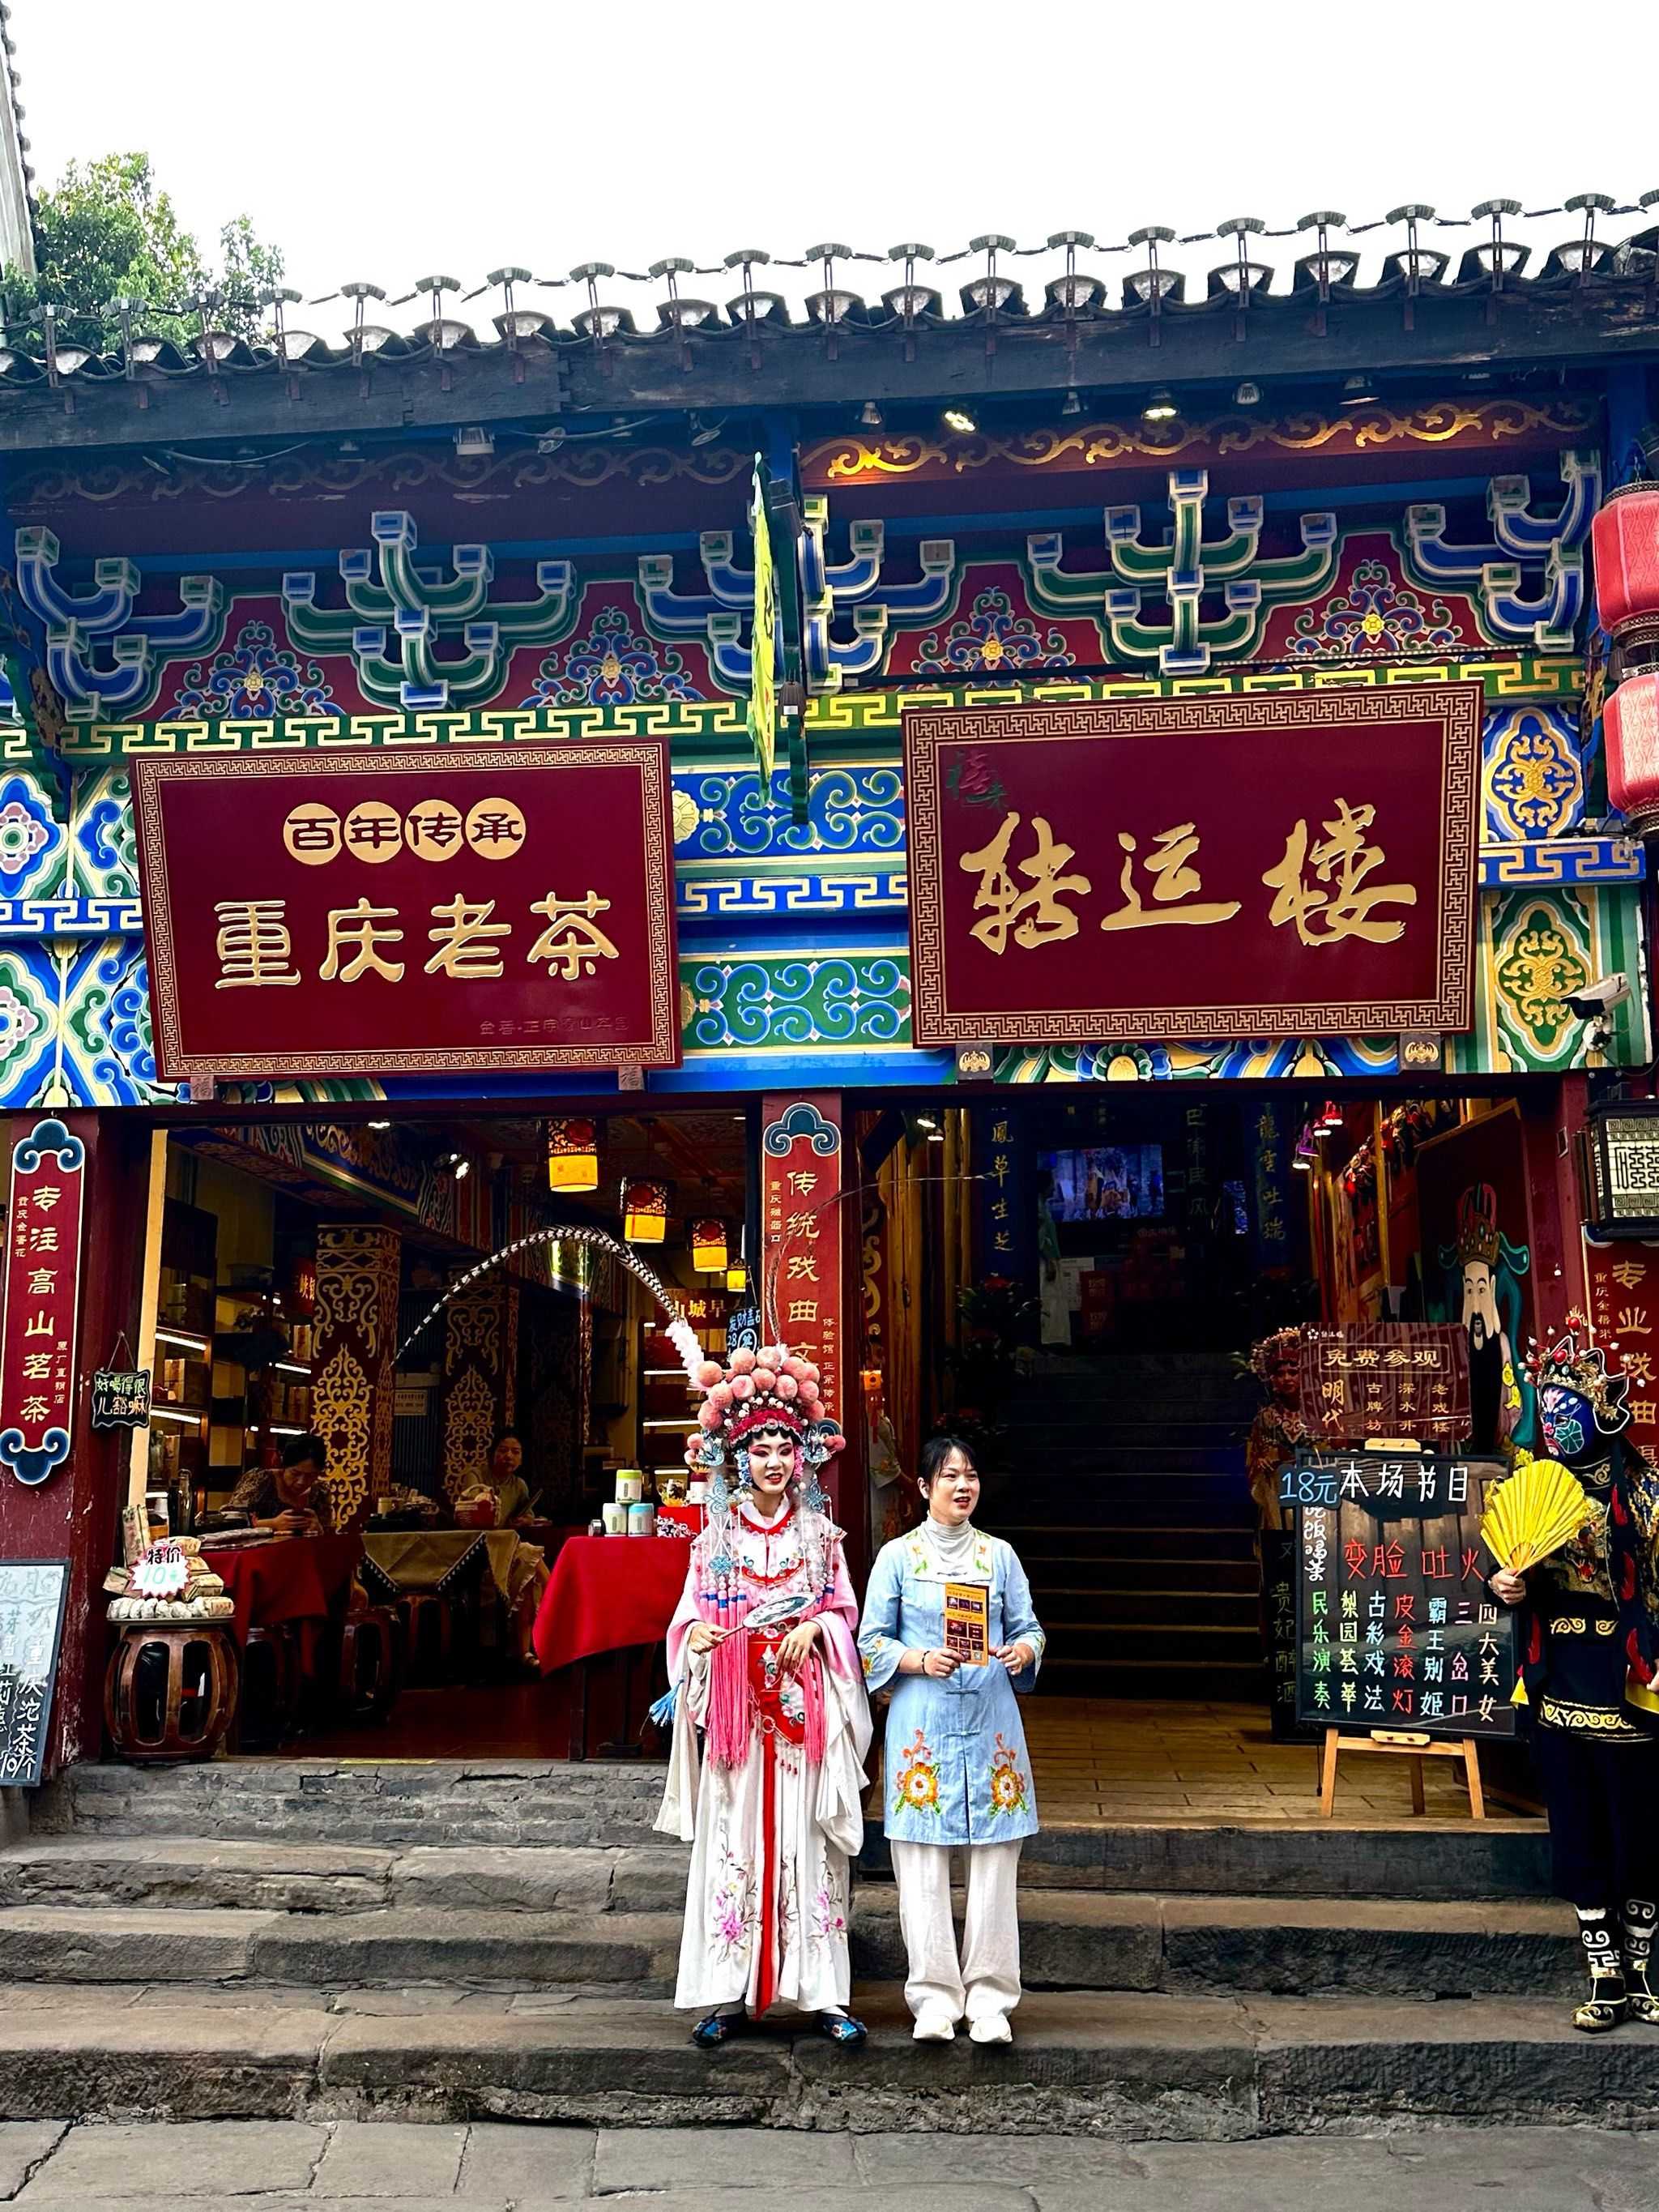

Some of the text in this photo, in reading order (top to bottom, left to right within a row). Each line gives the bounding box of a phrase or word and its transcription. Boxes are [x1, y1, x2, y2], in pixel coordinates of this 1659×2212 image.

[284, 804, 525, 858] 百年传承
[960, 798, 1418, 954] 转运楼
[214, 890, 619, 989] 重庆老茶
[20, 1185, 62, 1424] 专注高山茗茶
[1322, 1379, 1345, 1433] 明代
[1324, 1348, 1442, 1368] 免费参观
[1365, 1382, 1384, 1432] 古牌坊
[1397, 1382, 1418, 1433] 深水井
[1431, 1382, 1451, 1433] 老戏楼
[1280, 1471, 1337, 1504] 18元
[1339, 1461, 1469, 1502] 本场节目
[147, 1547, 181, 1565] 特价
[13, 1638, 48, 1756] 重庆沱茶
[1312, 1590, 1331, 1710] 民乐演奏
[1339, 1590, 1359, 1713] 梨园荟萃
[1363, 1590, 1386, 1712] 古彩戏法
[1392, 1594, 1417, 1715] 皮金滚灯
[1419, 1597, 1448, 1717] 霸王别姬
[1451, 1602, 1473, 1716] 三岔口
[1478, 1603, 1499, 1723] 四大美女
